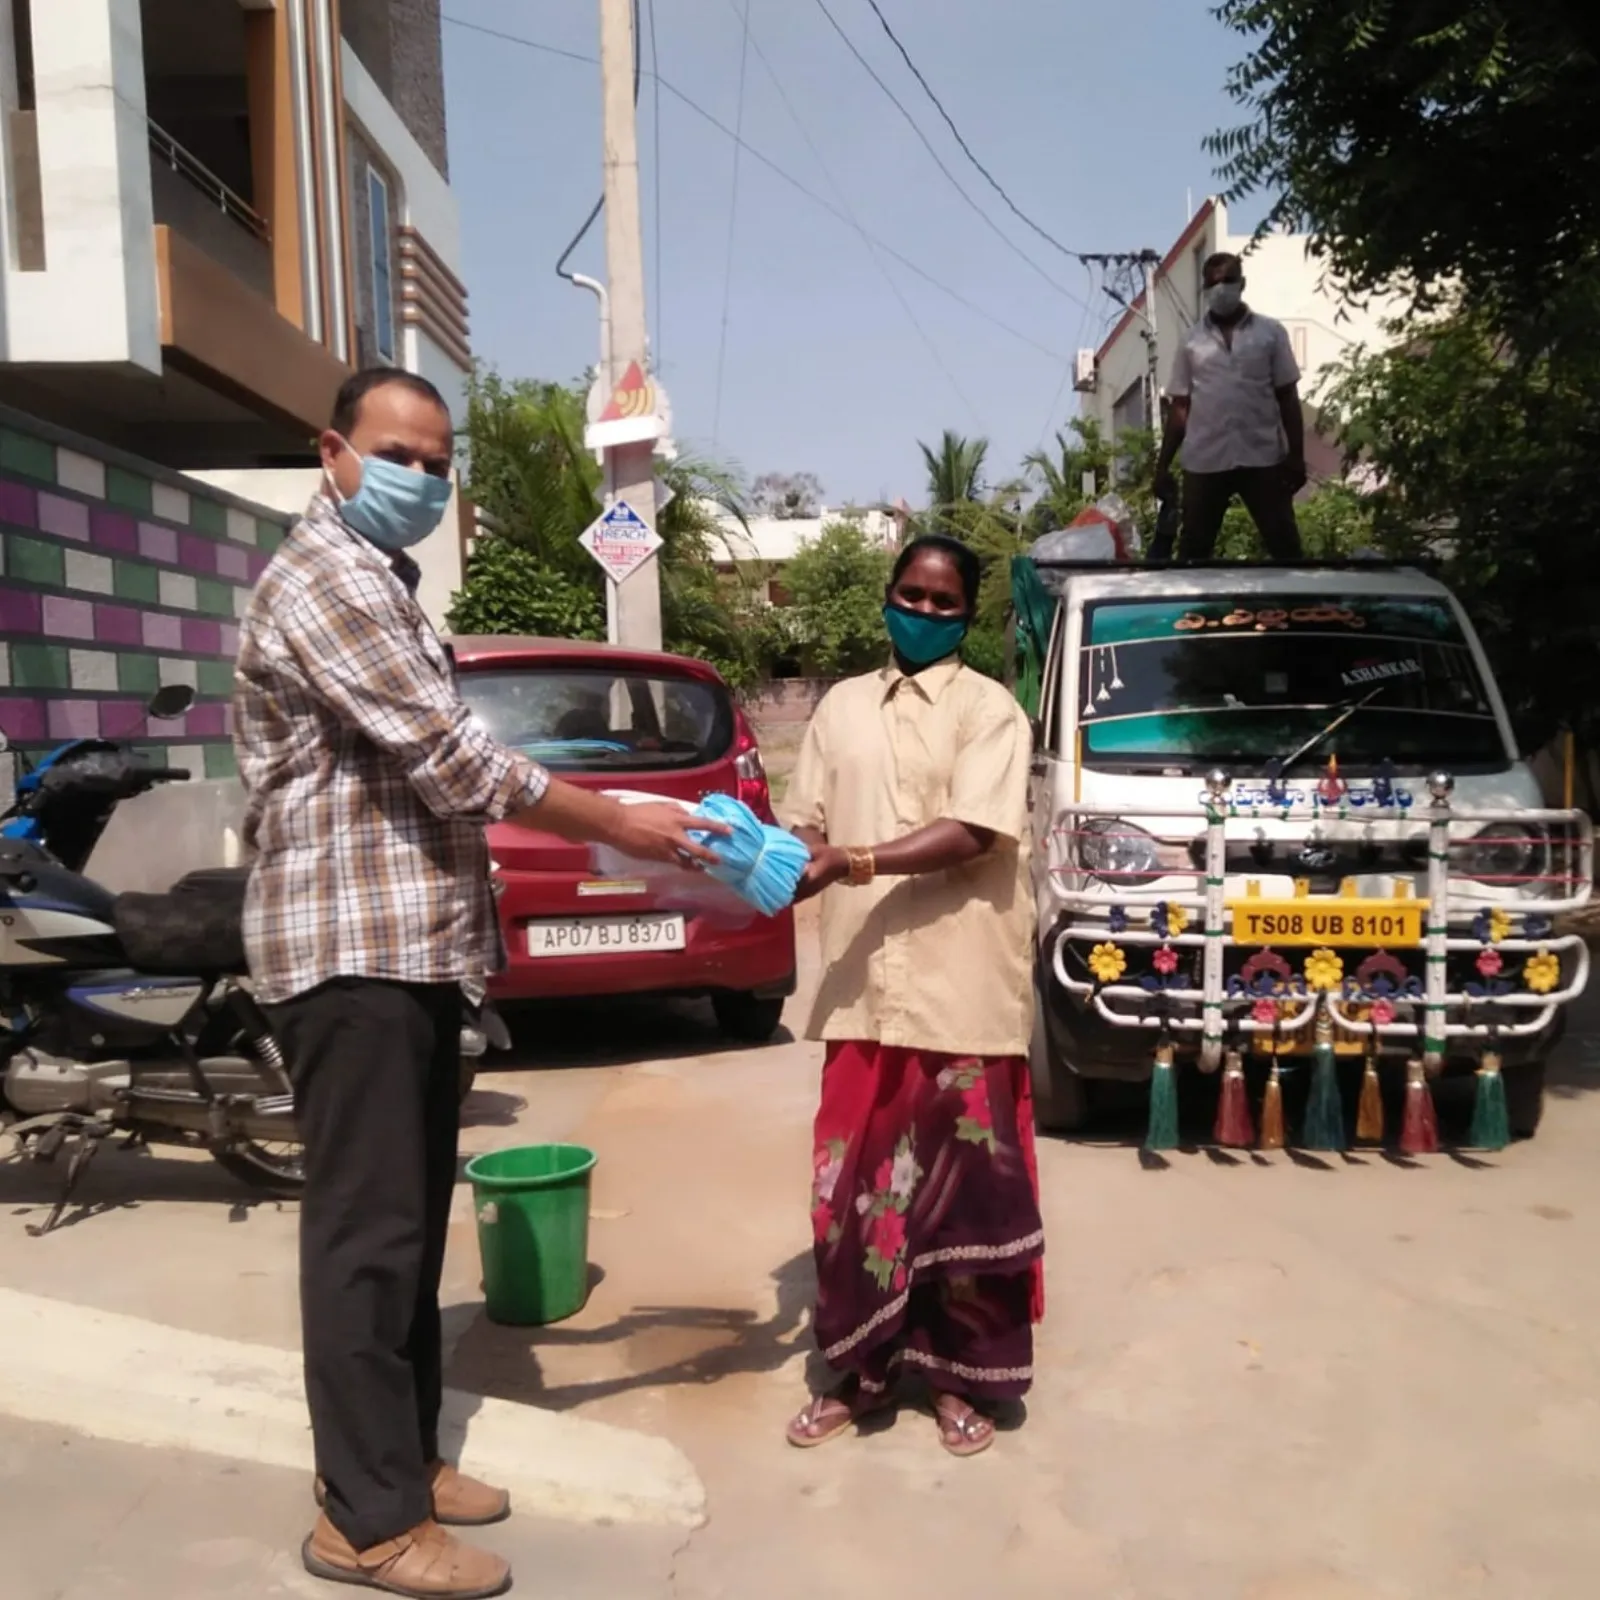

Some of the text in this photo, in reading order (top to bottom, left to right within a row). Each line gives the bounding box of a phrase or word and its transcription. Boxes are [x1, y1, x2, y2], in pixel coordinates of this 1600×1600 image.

[544, 922, 676, 948] AP07 BJ 8370
[1247, 914, 1405, 936] TS08 UB 8101
